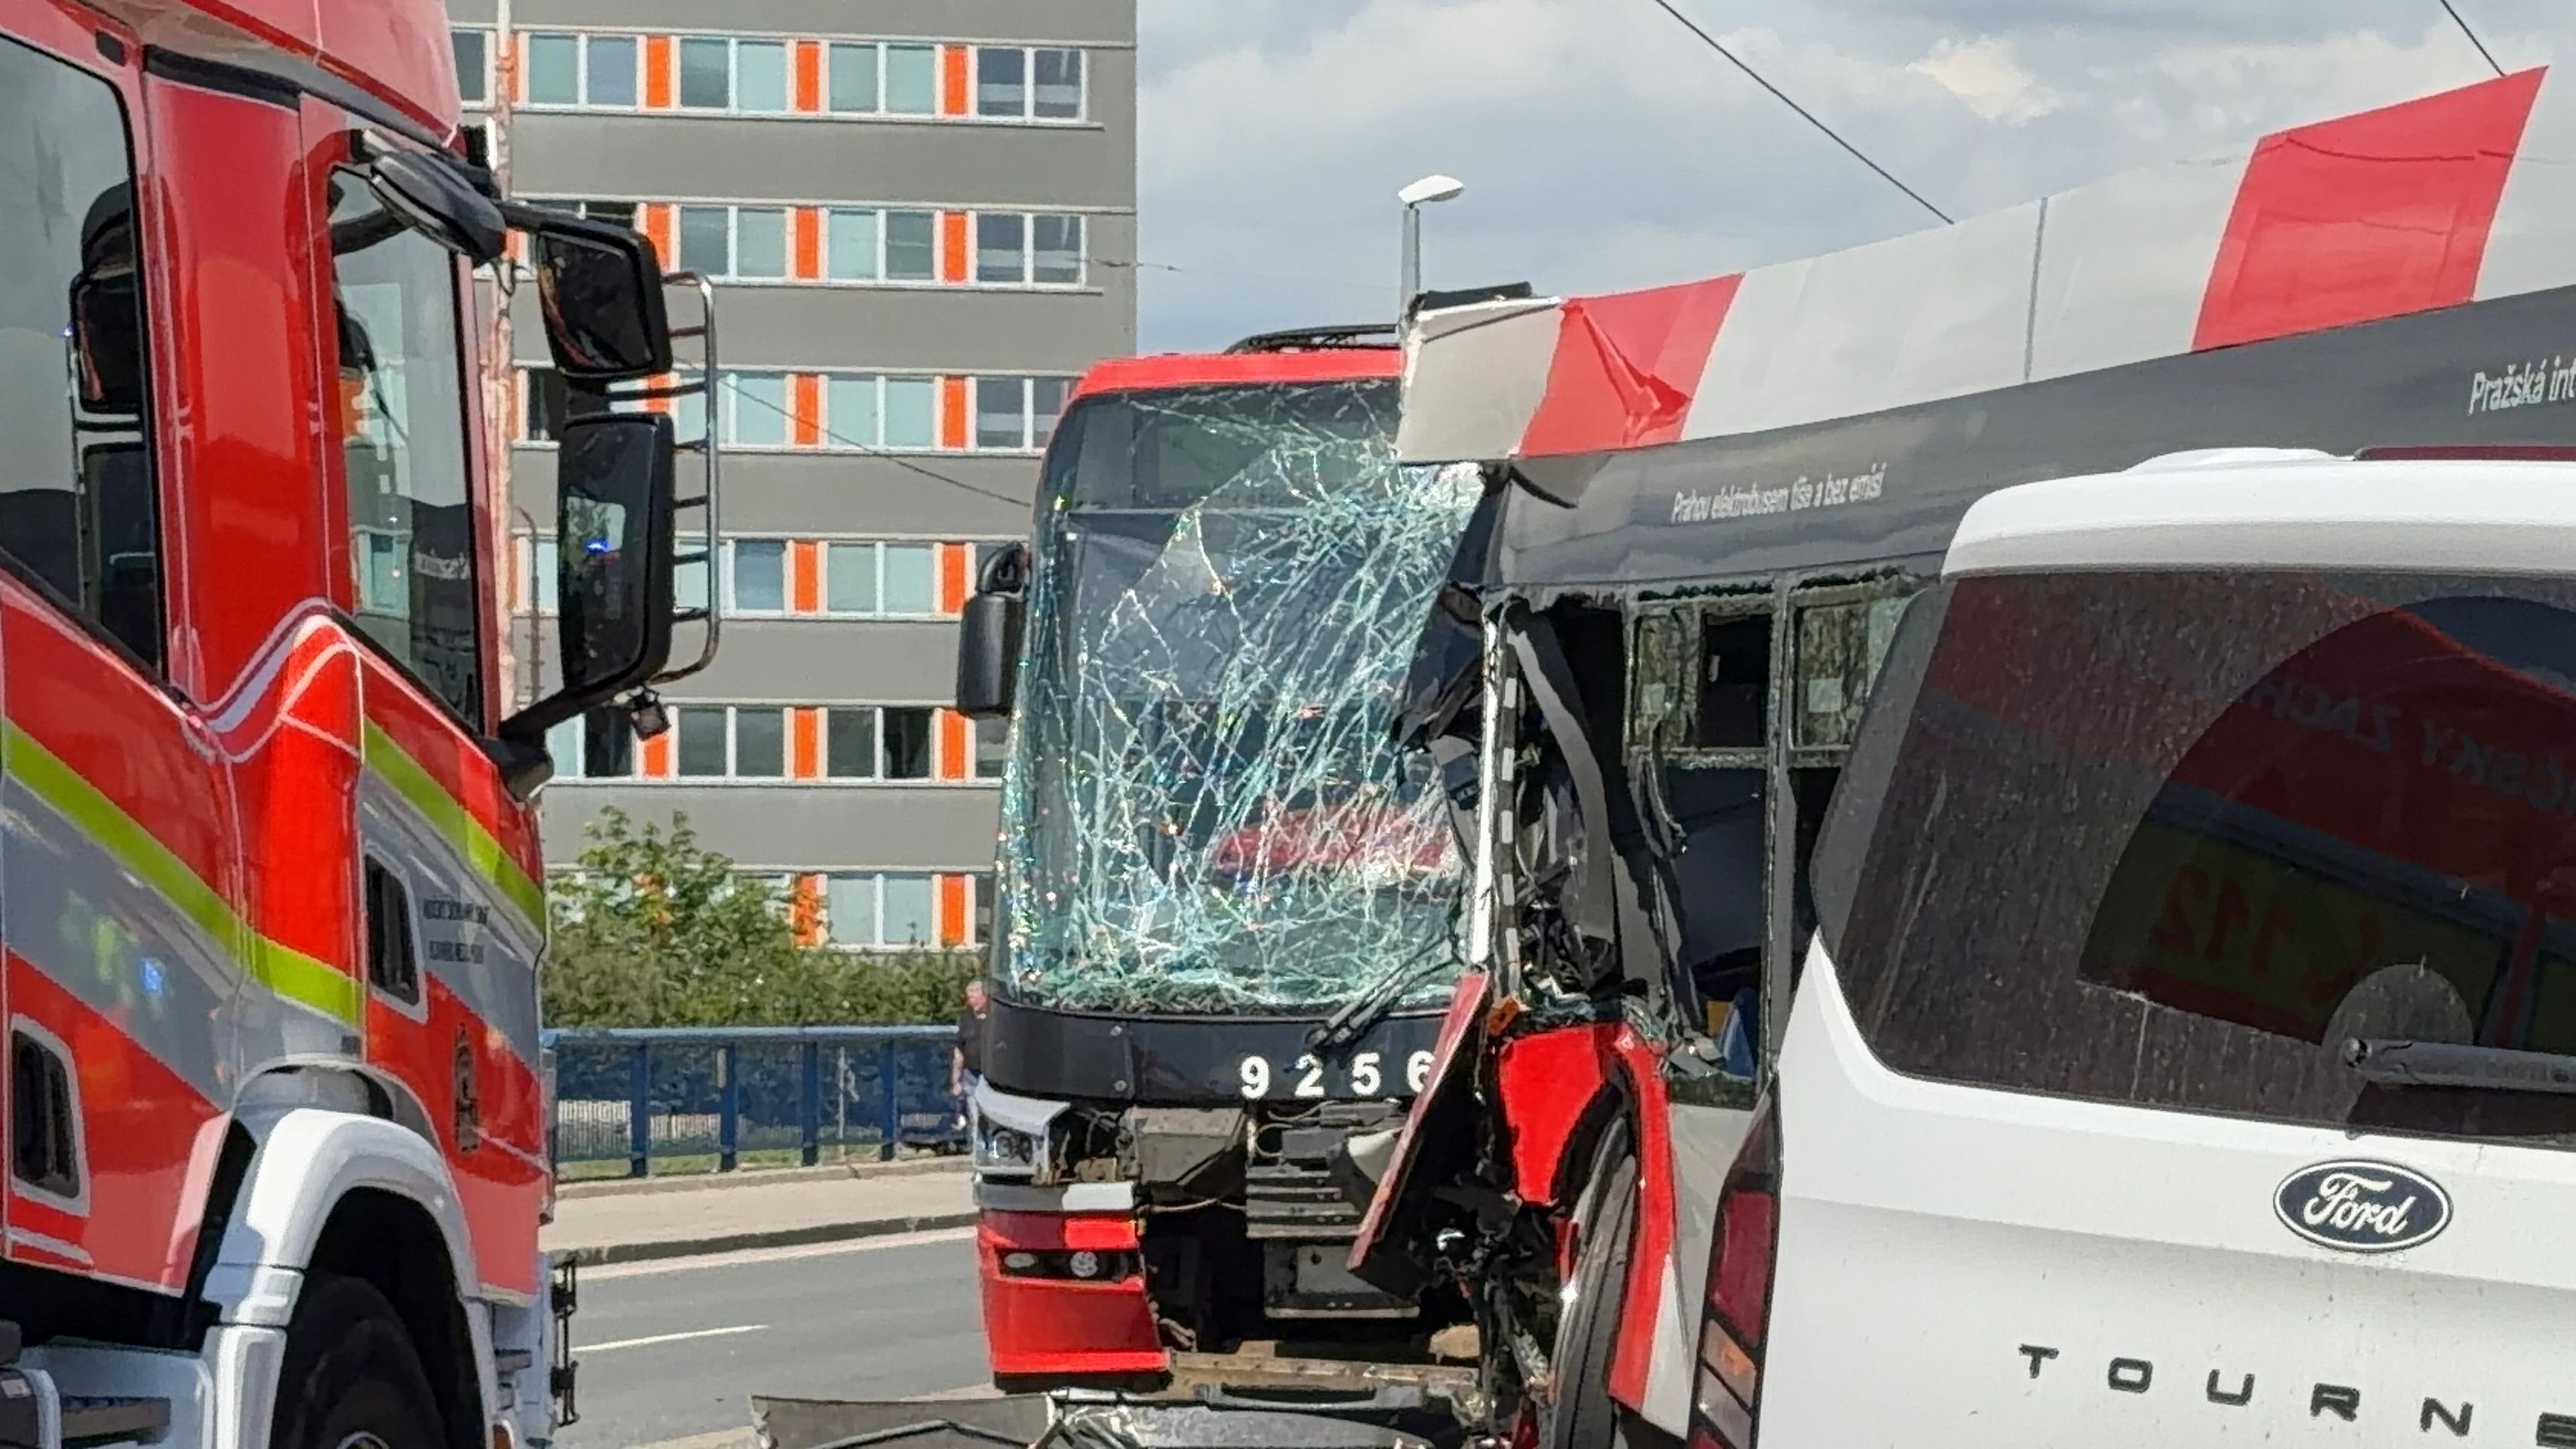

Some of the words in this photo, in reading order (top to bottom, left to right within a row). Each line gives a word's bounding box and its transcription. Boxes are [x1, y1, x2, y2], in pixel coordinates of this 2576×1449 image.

[2467, 358, 2547, 416] Pražská
[1671, 490, 1712, 523] Prahou
[1711, 480, 1789, 519] elektrobusem
[1813, 481, 1824, 507] a
[1823, 472, 1848, 506] bez
[1240, 1050, 1436, 1100] 9256
[2304, 1173, 2417, 1235] Ford
[2018, 1343, 2576, 1449] TOURNE
